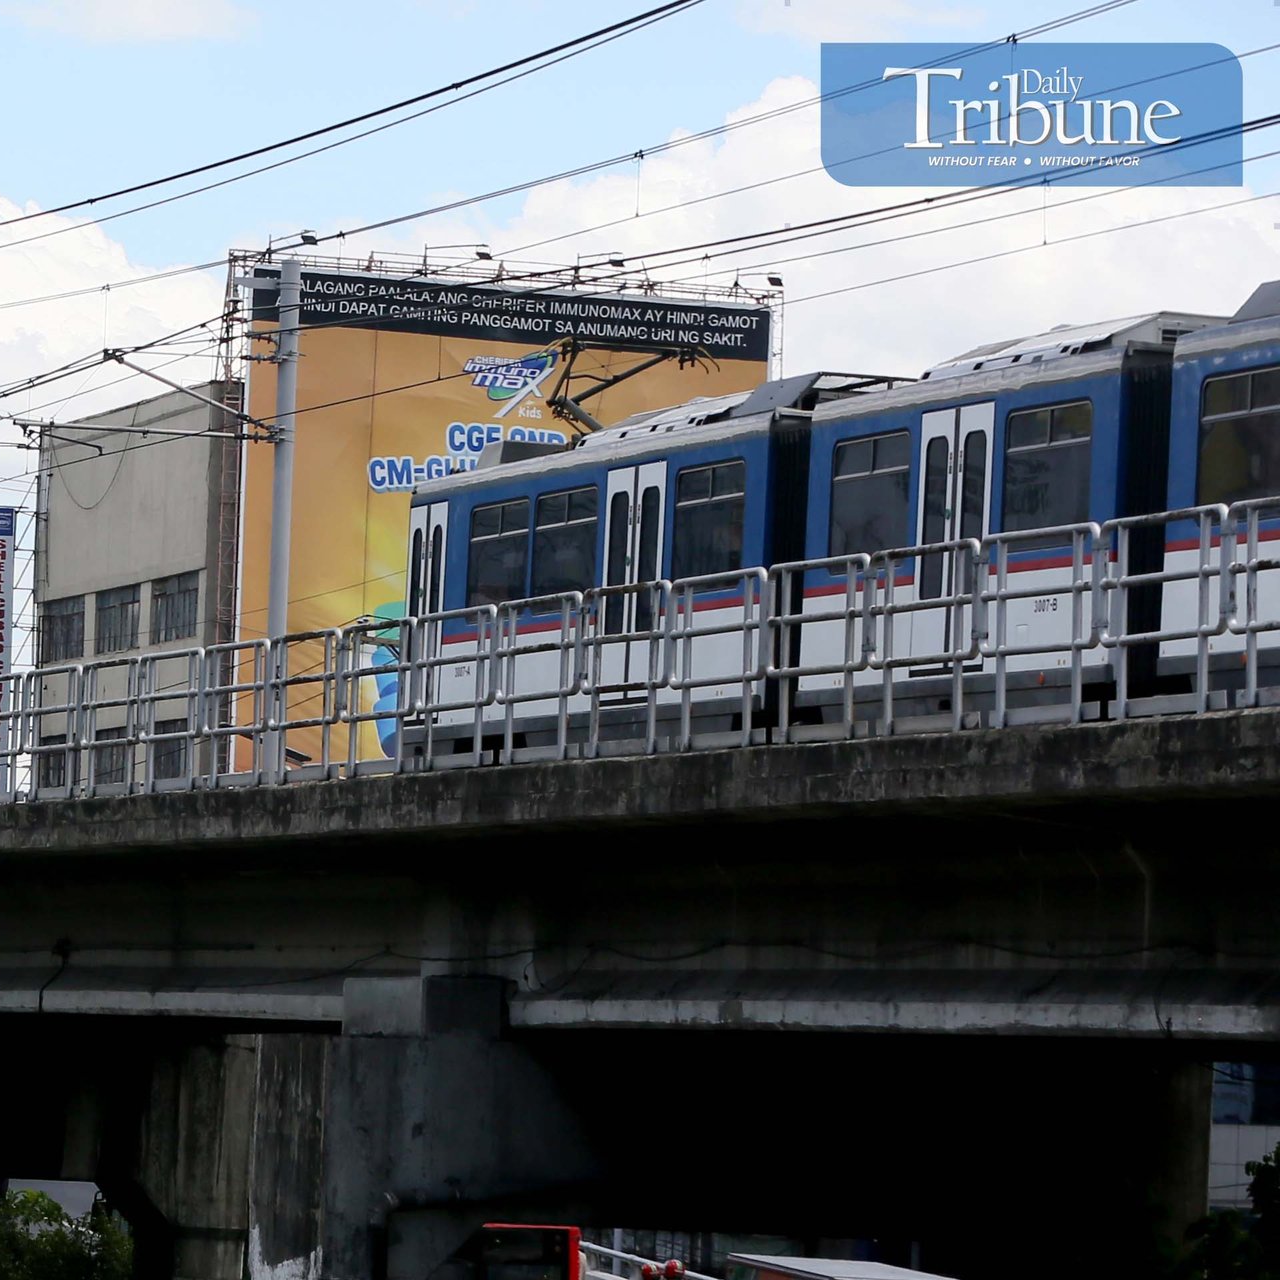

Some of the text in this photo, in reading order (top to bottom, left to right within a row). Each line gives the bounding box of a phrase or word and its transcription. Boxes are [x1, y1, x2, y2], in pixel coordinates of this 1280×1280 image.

[339, 301, 387, 316] DAPAT
[460, 312, 552, 332] PANGGAMOT
[554, 319, 574, 334] SA
[576, 323, 648, 339] ANUMANG
[650, 327, 675, 341] URI
[678, 330, 700, 344] NG
[702, 332, 748, 347] SAKIT.
[437, 291, 468, 306] ANG
[549, 301, 642, 321] IMMUNOMAX
[643, 310, 663, 322] AY
[666, 311, 704, 325] HINDI
[707, 313, 760, 330] GAMOT
[518, 406, 542, 419] Kids
